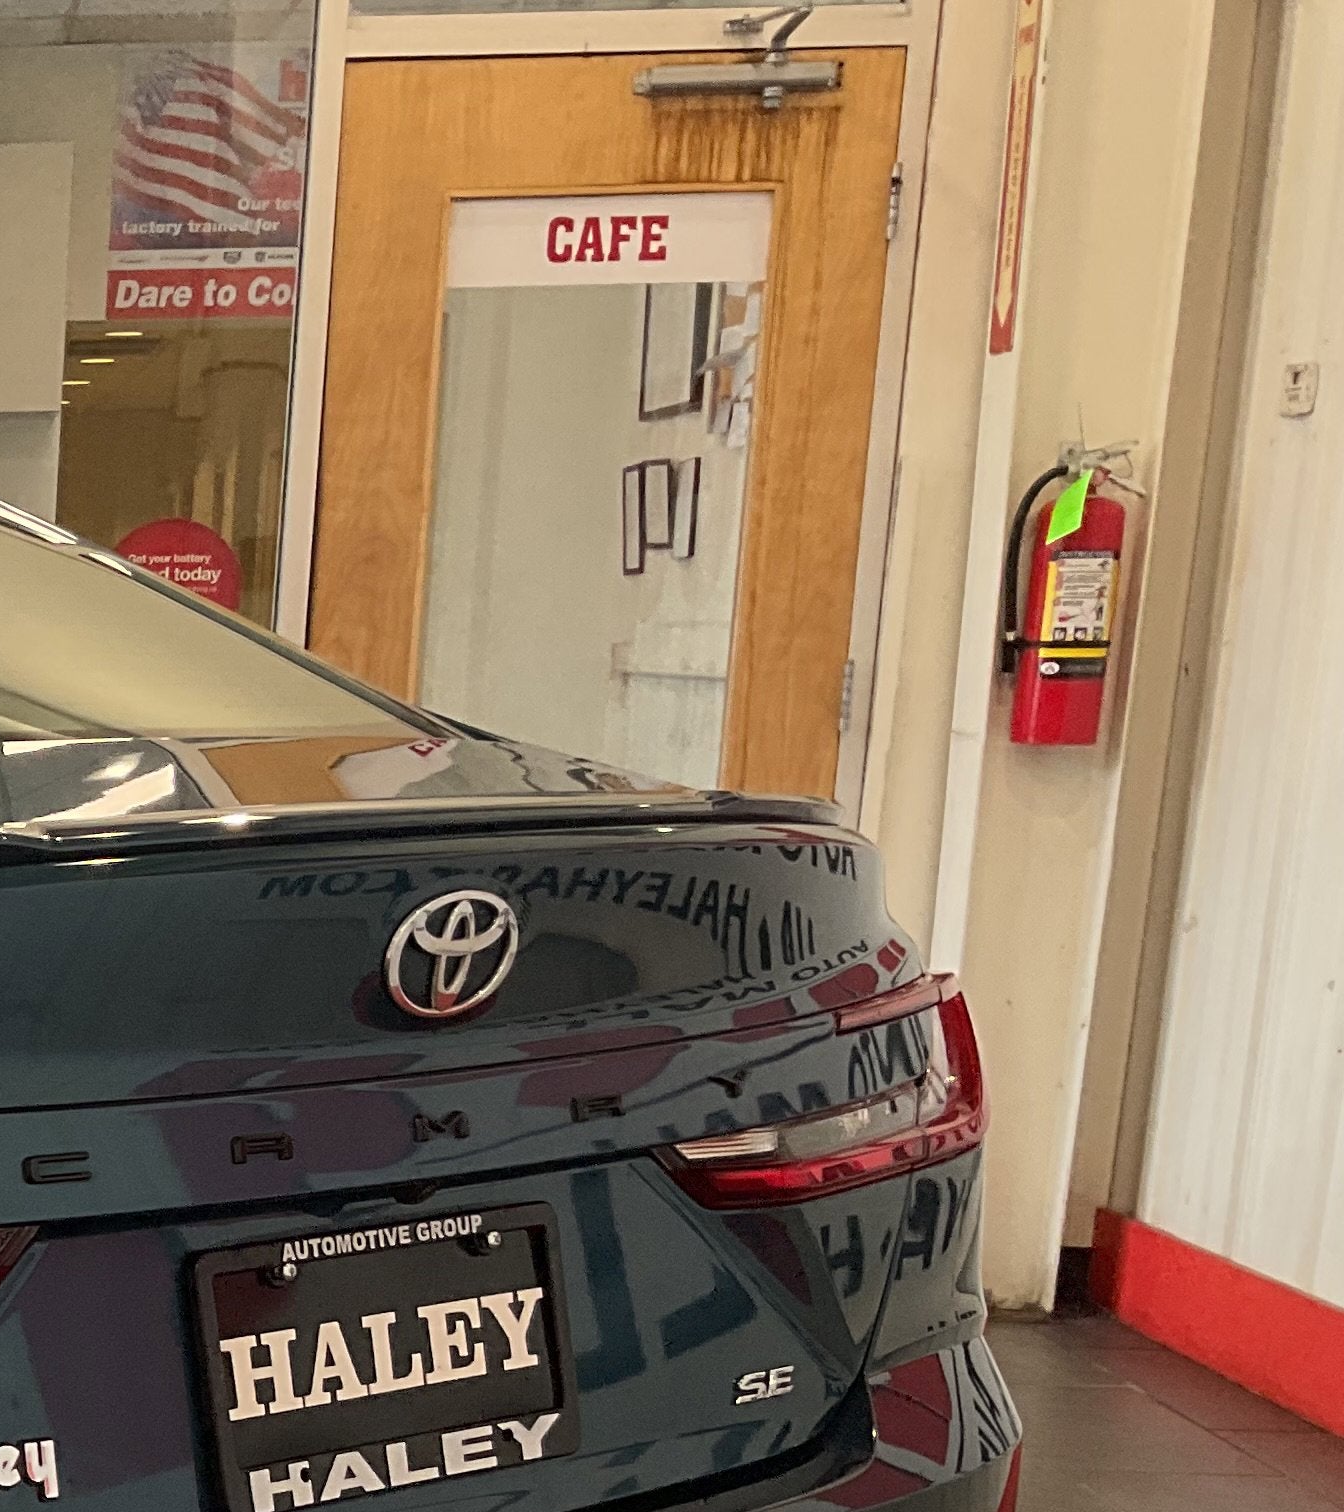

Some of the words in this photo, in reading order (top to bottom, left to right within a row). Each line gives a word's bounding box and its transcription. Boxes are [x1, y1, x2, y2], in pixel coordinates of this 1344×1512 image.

[238, 198, 269, 211] Our
[122, 221, 182, 236] factory
[254, 218, 280, 235] for
[546, 215, 669, 264] CAFE
[114, 280, 192, 309] Dare
[203, 278, 237, 307] to
[247, 276, 295, 306] Co
[148, 554, 172, 565] your
[173, 553, 212, 564] battery
[174, 566, 222, 584] today
[21, 1069, 749, 1185] CAMRY
[282, 1224, 411, 1262] AUTOMOTIVE
[416, 1214, 483, 1242] GROUP
[219, 1287, 544, 1422] HALEY
[735, 1365, 794, 1404] SE
